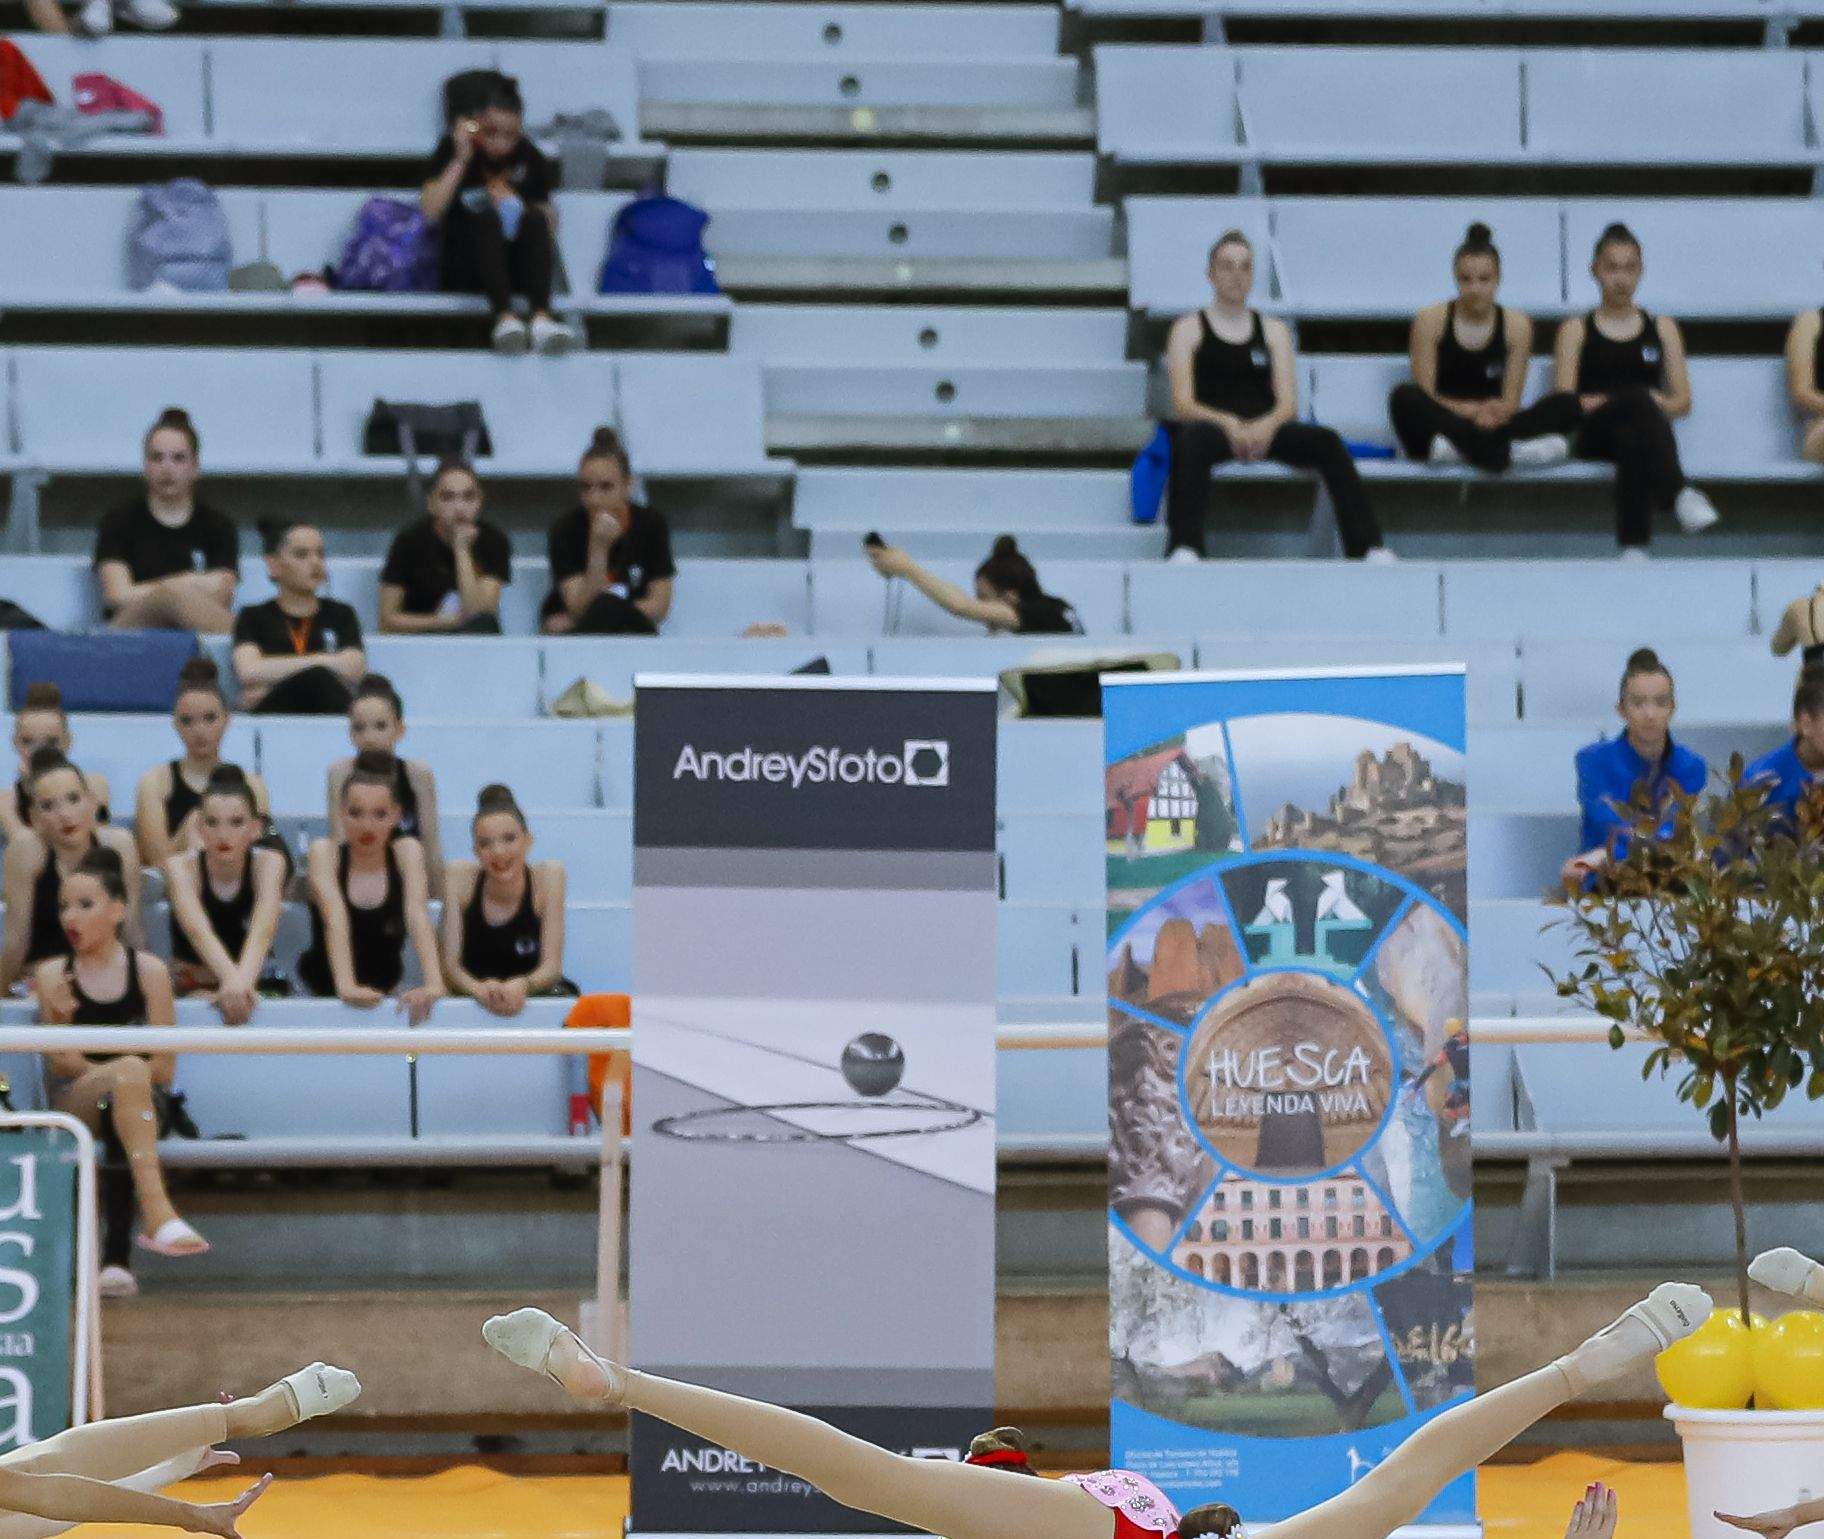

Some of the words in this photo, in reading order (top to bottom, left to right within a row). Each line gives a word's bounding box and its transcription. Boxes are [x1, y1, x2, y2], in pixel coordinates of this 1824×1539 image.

[673, 744, 903, 788] AndreySfoto
[1207, 1041, 1372, 1089] HUESCA
[1212, 1091, 1316, 1116] LEYENDA
[1319, 1090, 1368, 1114] VIVA
